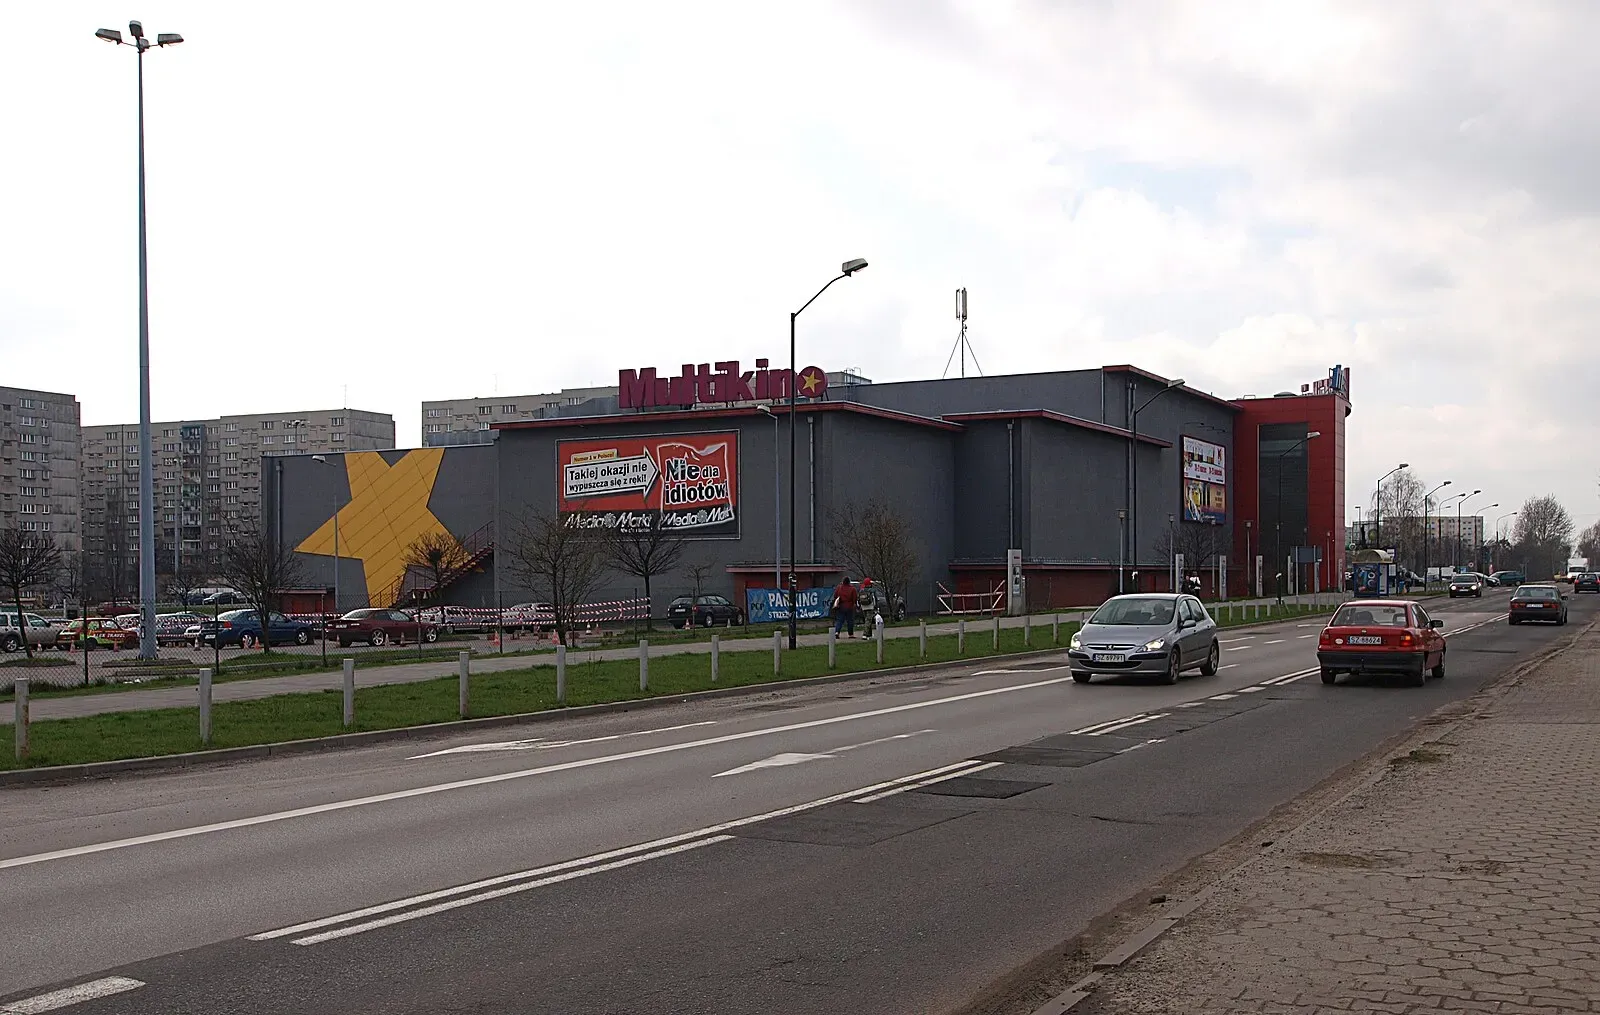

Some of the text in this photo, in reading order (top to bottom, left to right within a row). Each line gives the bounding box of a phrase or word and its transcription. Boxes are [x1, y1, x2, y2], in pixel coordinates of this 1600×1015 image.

[619, 358, 828, 409] Multikino
[569, 461, 647, 480] Takiej okazji nie
[665, 458, 719, 482] Nie dla
[569, 480, 608, 492] wypuszcza
[610, 477, 621, 486] się
[564, 513, 604, 529] Media
[768, 592, 818, 607] PARING
